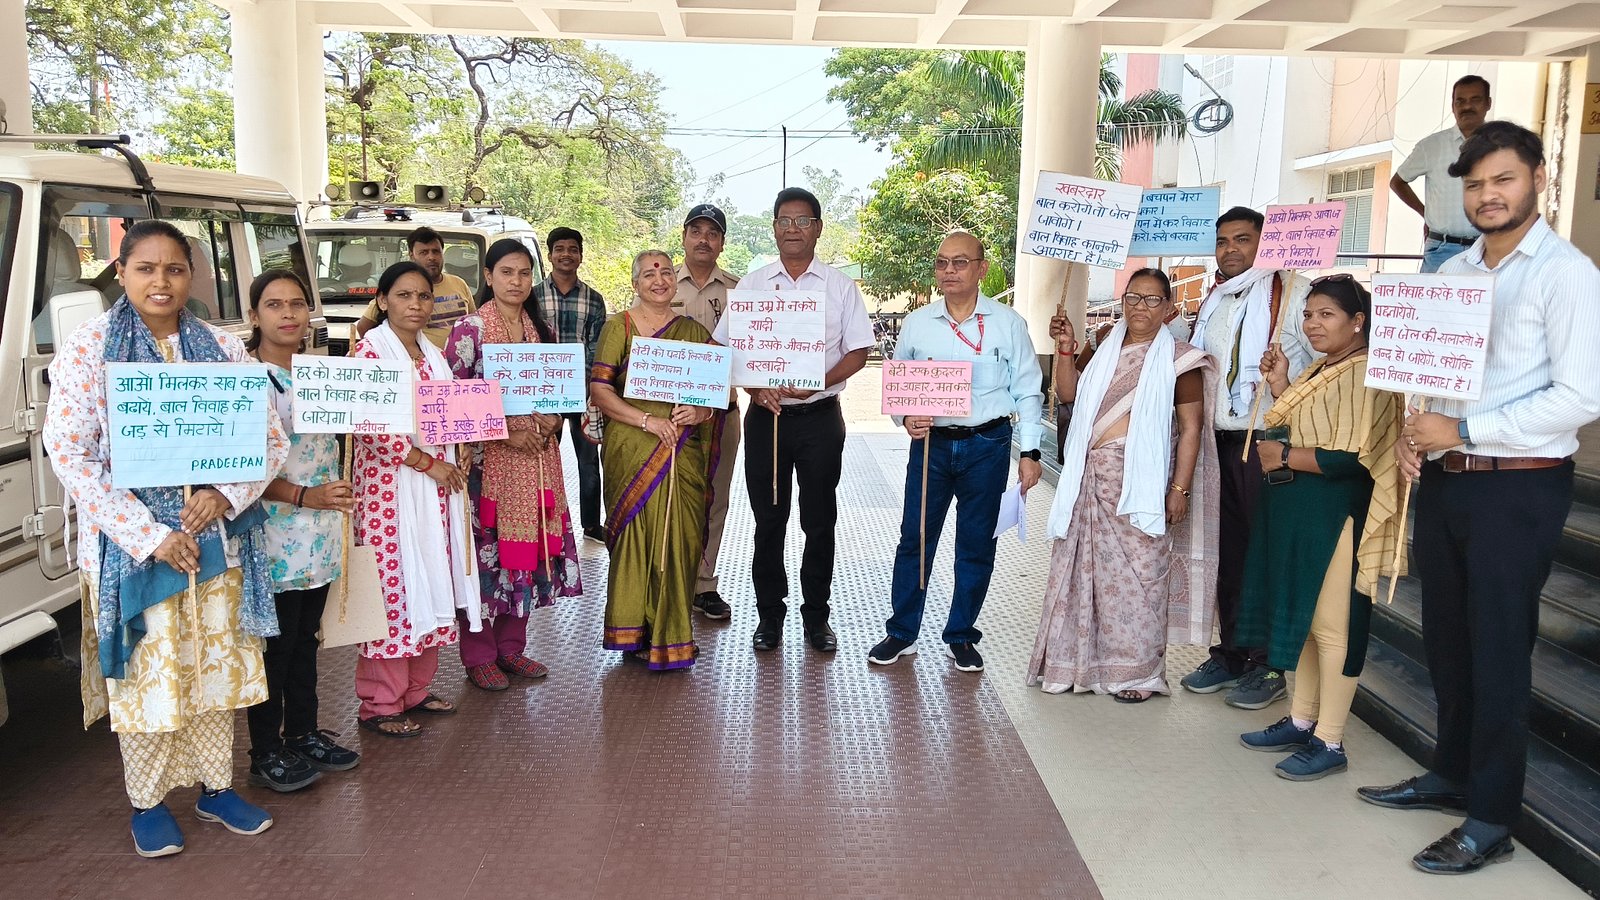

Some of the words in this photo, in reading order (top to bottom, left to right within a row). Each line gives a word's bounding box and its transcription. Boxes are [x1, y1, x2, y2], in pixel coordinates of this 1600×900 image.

[1056, 183, 1106, 202] खबरदार
[1146, 193, 1177, 202] बचपन
[1178, 190, 1203, 202] मेरा
[1036, 198, 1057, 209] बाल
[1110, 203, 1136, 220] जेल
[1288, 209, 1312, 222] मिलकर
[1181, 215, 1214, 227] विवाह
[1029, 230, 1051, 243] बाल
[1304, 225, 1326, 239] विवाह
[1032, 245, 1082, 260] अपराध
[1374, 285, 1395, 297] बाल
[1398, 282, 1424, 299] विवाह
[1426, 282, 1453, 300] करके
[1457, 288, 1486, 305] बहुत
[1398, 324, 1421, 340] जेल
[632, 342, 650, 356] बेटी
[757, 336, 782, 350] उसके
[784, 338, 811, 352] जीवन
[517, 353, 535, 363] अब
[519, 369, 539, 379] बाल
[543, 366, 576, 379] विवाह
[651, 359, 682, 375] योगदान
[889, 363, 907, 376] बेटी
[931, 367, 966, 378] कुदरत
[159, 372, 208, 392] मिलकर
[214, 376, 237, 391] सब
[333, 368, 362, 382] अगर
[650, 376, 674, 389] विवाह
[1368, 367, 1386, 379] बाल
[1388, 366, 1413, 384] विवाह
[1416, 373, 1452, 389] अपराध
[513, 386, 537, 395] नाश
[769, 378, 820, 388] PRADEEPAN
[886, 382, 899, 391] का
[297, 388, 320, 400] बाल
[325, 384, 356, 402] विवाह
[160, 400, 187, 414] बाल
[192, 395, 229, 415] विवाह
[887, 397, 918, 407] इसका
[919, 393, 966, 409] तिरस्कार
[302, 406, 346, 424] जायेगा
[454, 413, 474, 431] उसके
[153, 419, 170, 438] से
[191, 456, 264, 471] PRADEEPAN
